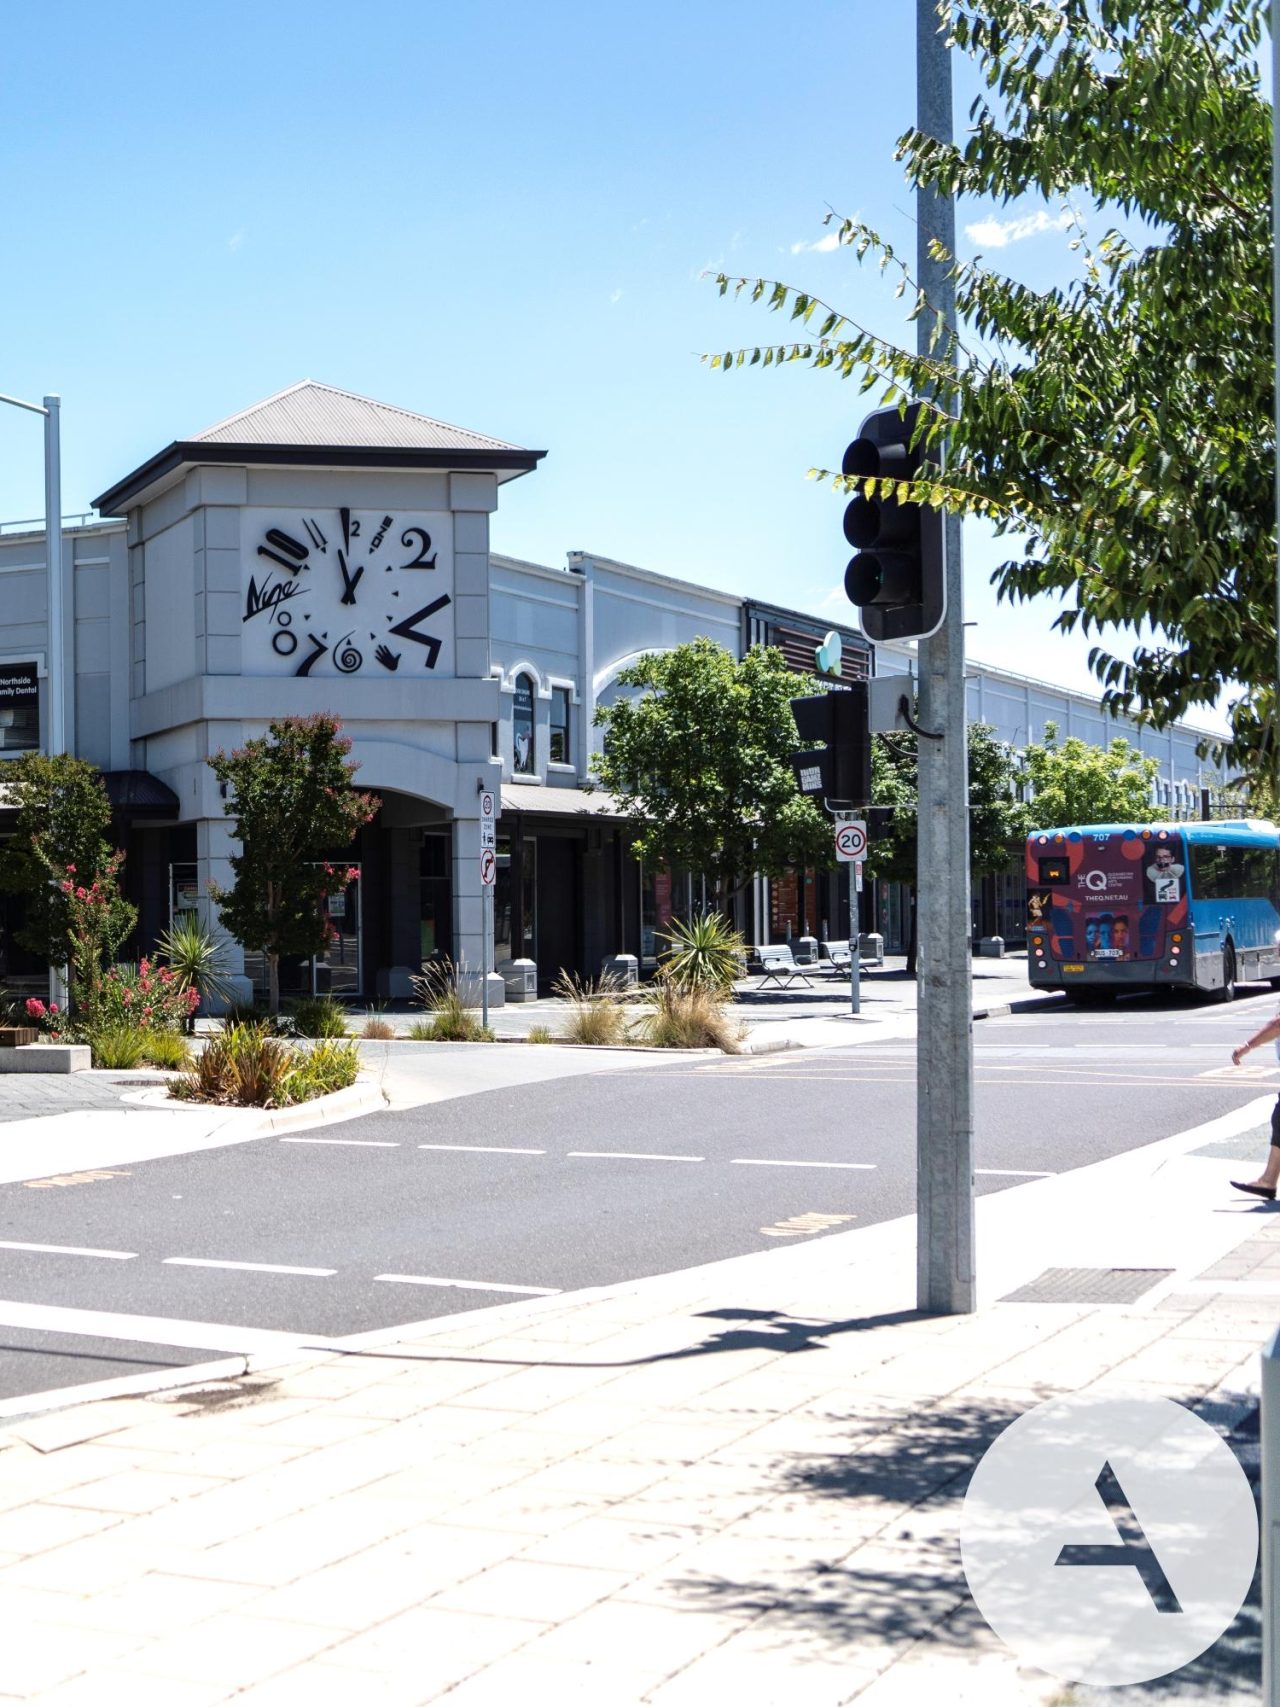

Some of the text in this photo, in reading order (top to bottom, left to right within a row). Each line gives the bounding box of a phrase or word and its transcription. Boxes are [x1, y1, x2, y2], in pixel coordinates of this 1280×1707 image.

[372, 515, 394, 550] ONE
[400, 527, 438, 570] 2
[242, 572, 311, 624] Nine
[0, 677, 31, 686] Northside
[15, 686, 37, 694] Dental
[841, 834, 862, 848] 20
[1093, 833, 1110, 842] 707
[1078, 874, 1086, 888] THE
[1086, 870, 1107, 890] Q
